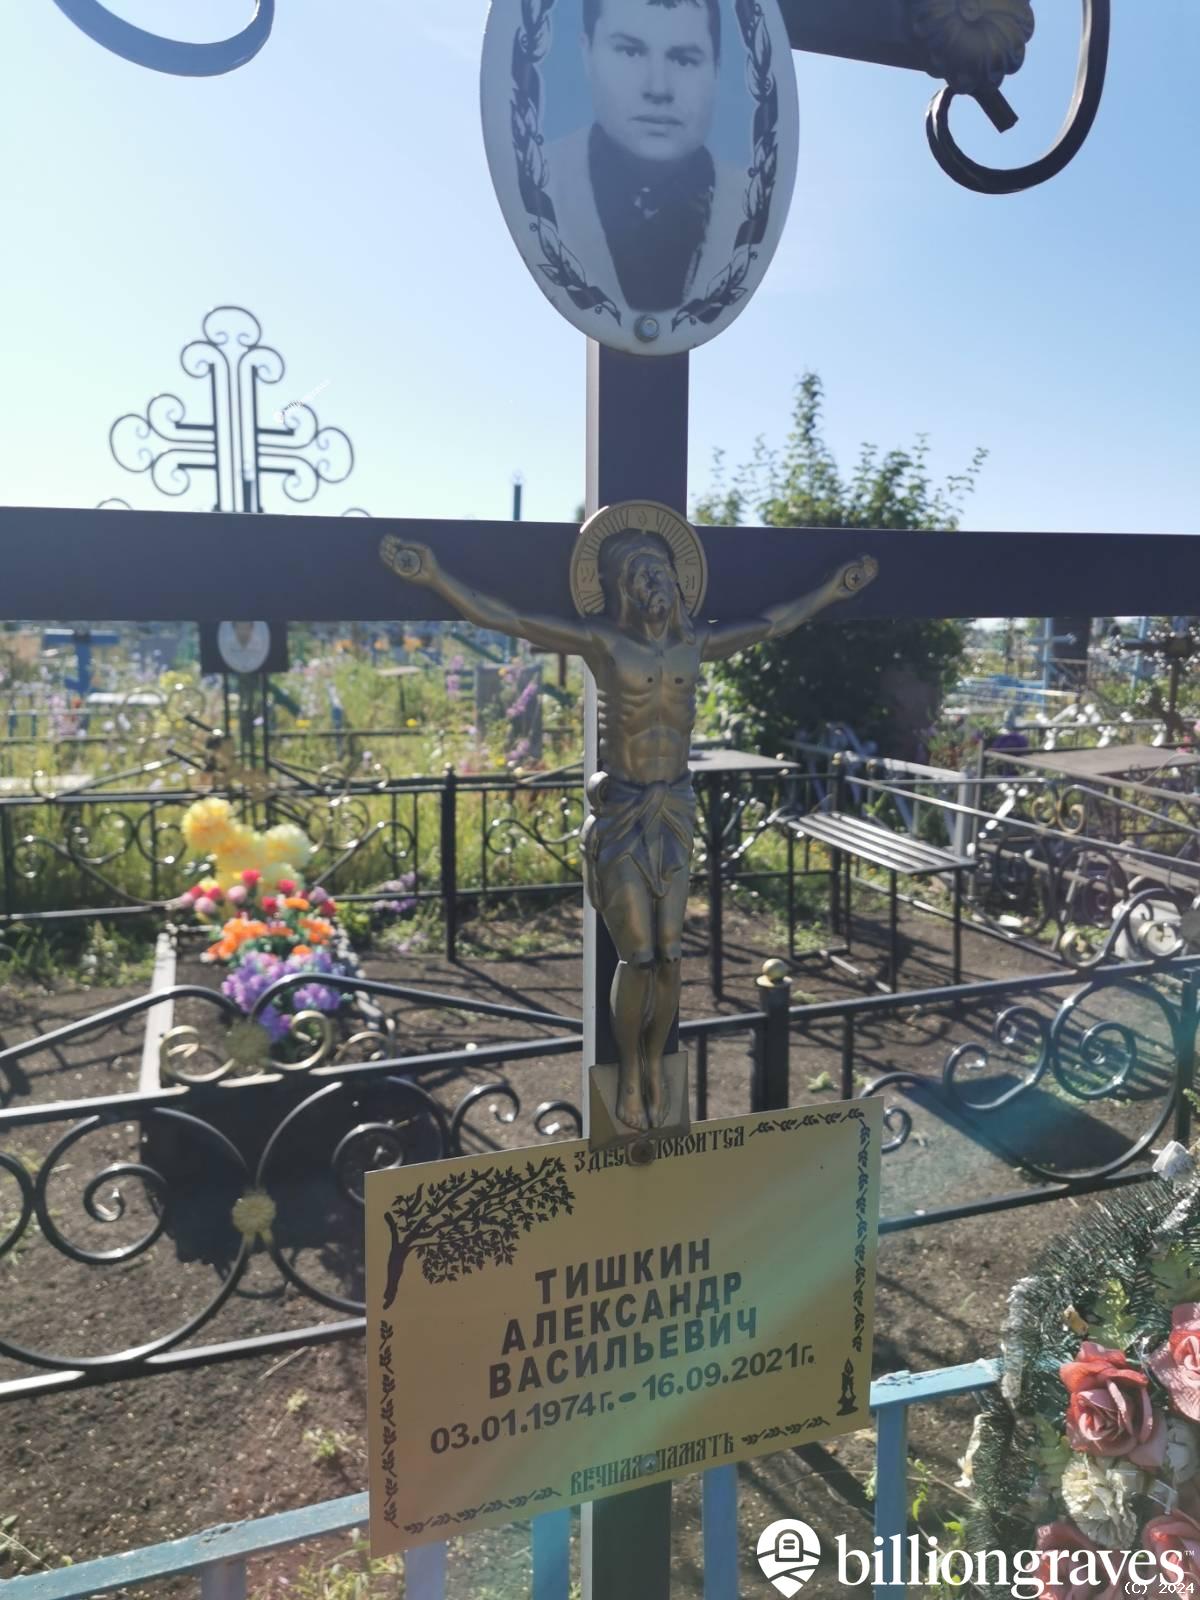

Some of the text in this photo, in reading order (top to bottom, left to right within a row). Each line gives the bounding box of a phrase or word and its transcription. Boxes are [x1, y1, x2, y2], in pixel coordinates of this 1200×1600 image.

[574, 1145, 629, 1173] ЗДЕС
[535, 1238, 710, 1304] ТИШКИН
[501, 1271, 742, 1355] АЛЕКСАНДР
[489, 1306, 757, 1399] ВАСИЛЬЕВИЧ
